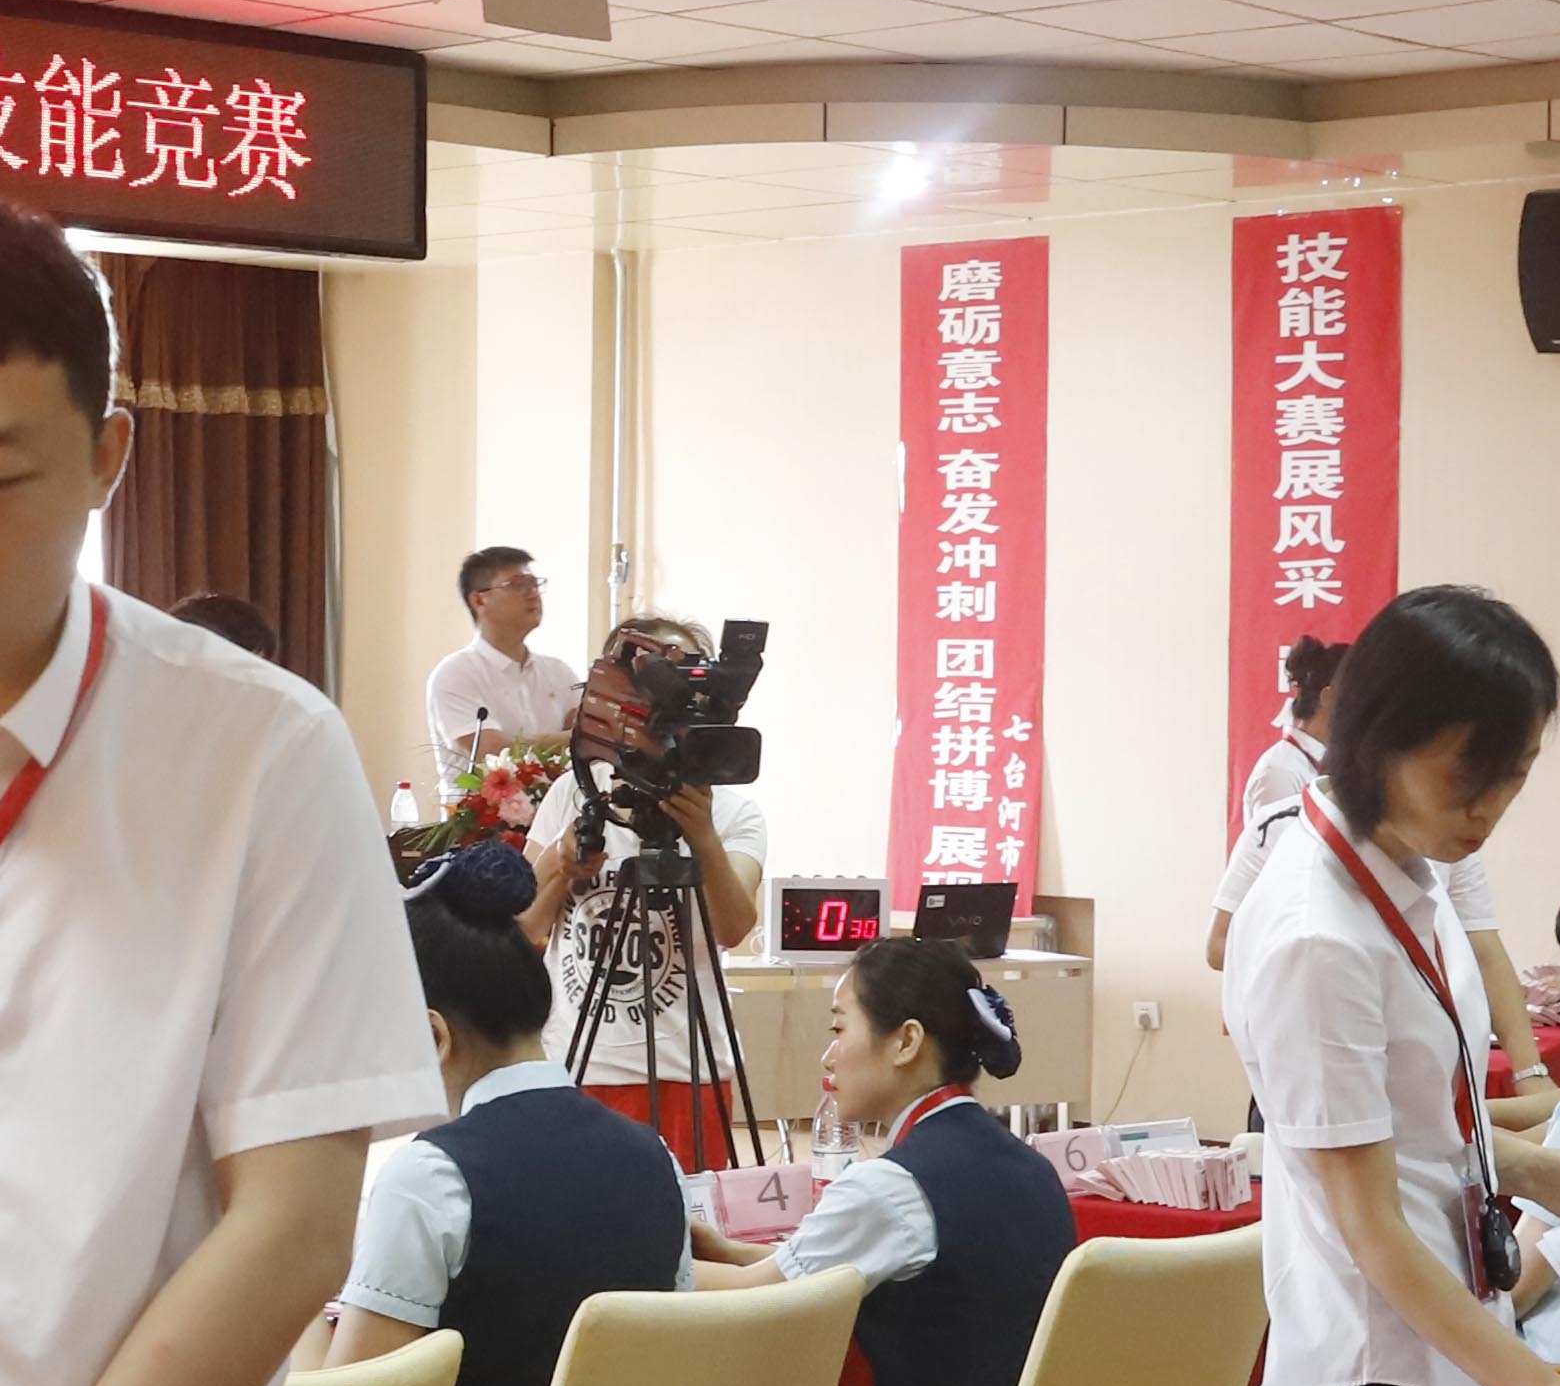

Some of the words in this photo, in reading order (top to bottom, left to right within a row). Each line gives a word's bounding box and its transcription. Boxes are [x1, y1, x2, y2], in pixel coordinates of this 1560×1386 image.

[937, 259, 1002, 434] 磨砺意志
[1272, 231, 1349, 609] 技能大赛展风采
[935, 448, 1001, 623] 奋发冲刺
[996, 714, 1033, 883] 七台河市
[757, 1172, 789, 1211] 4
[1065, 1134, 1087, 1171] 6
